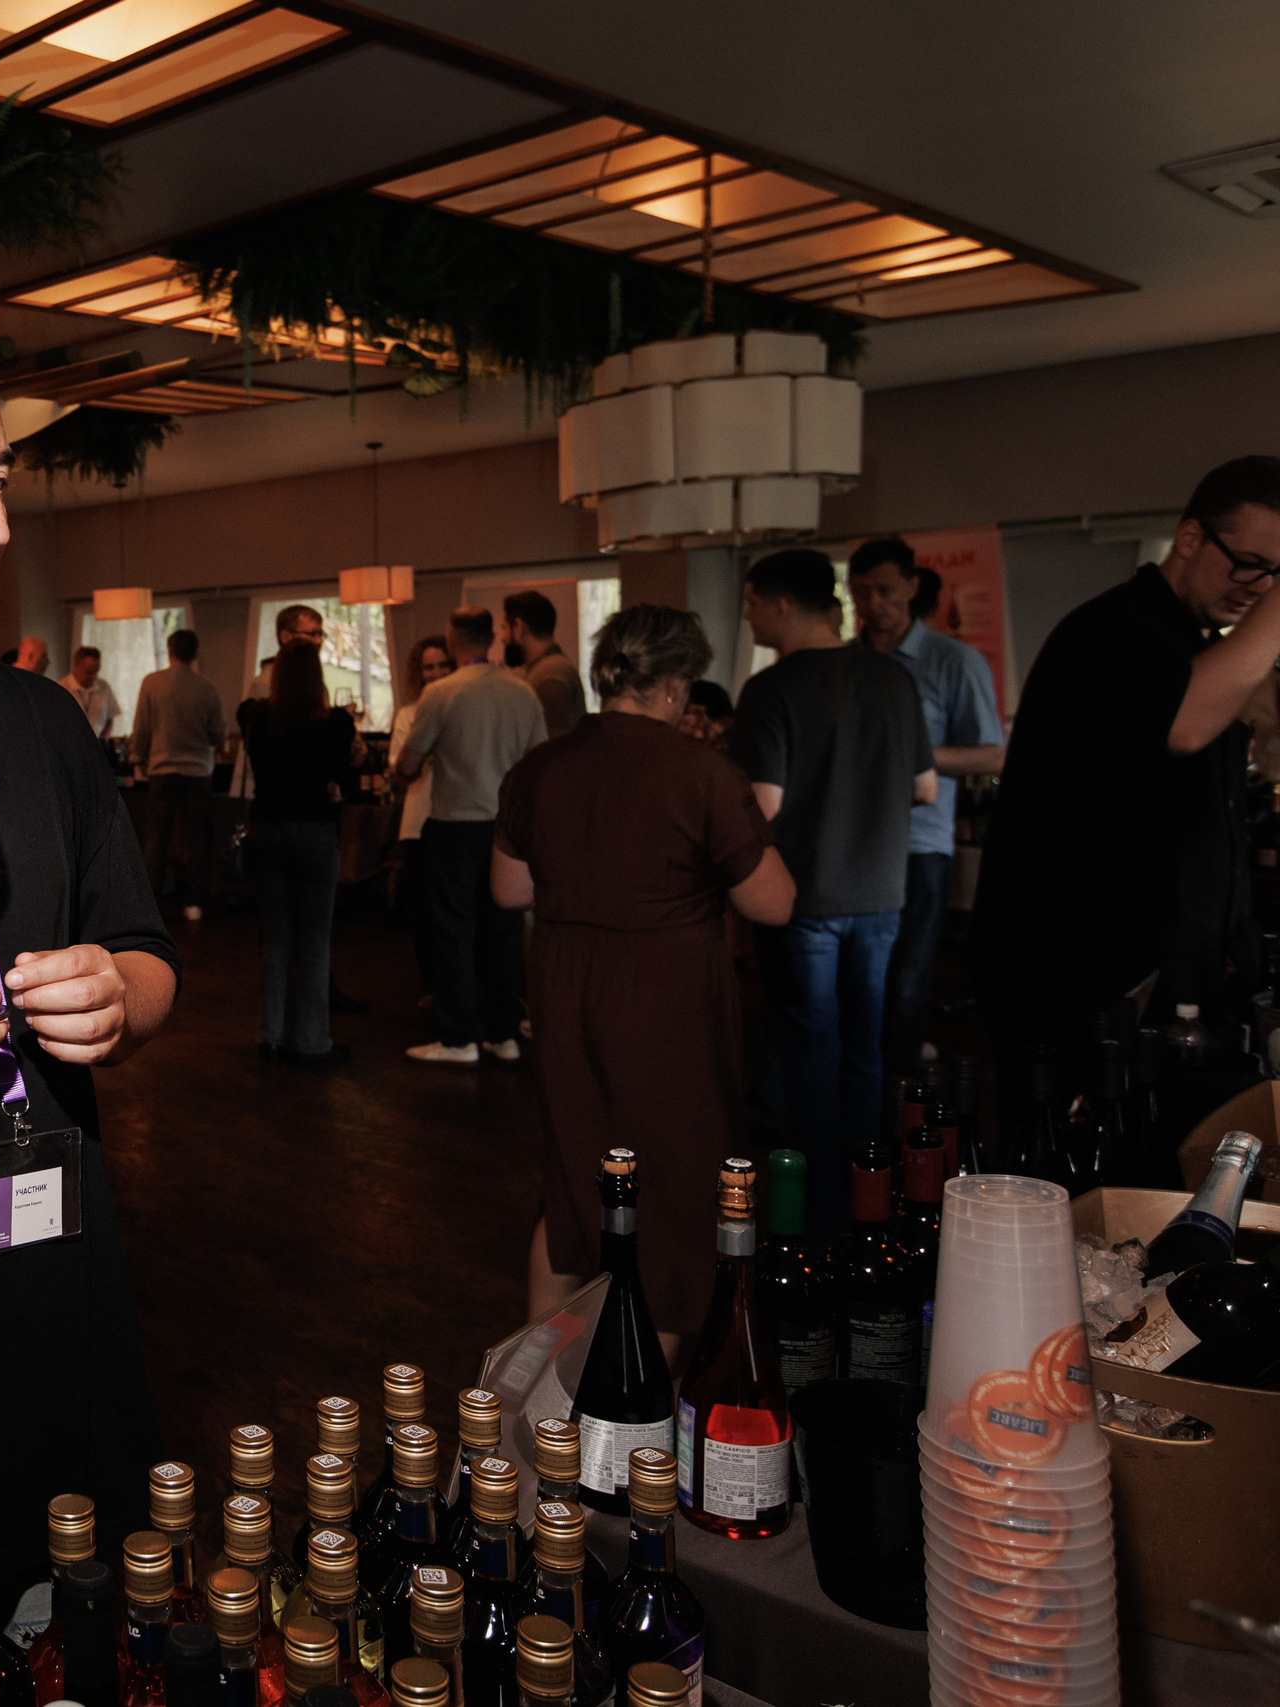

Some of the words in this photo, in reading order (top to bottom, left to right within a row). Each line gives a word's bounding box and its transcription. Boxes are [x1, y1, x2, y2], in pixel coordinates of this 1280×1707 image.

[15, 1183, 48, 1197] УЧАСТНИК
[585, 1418, 608, 1429] CASPICO
[990, 1409, 1045, 1432] LIGARE
